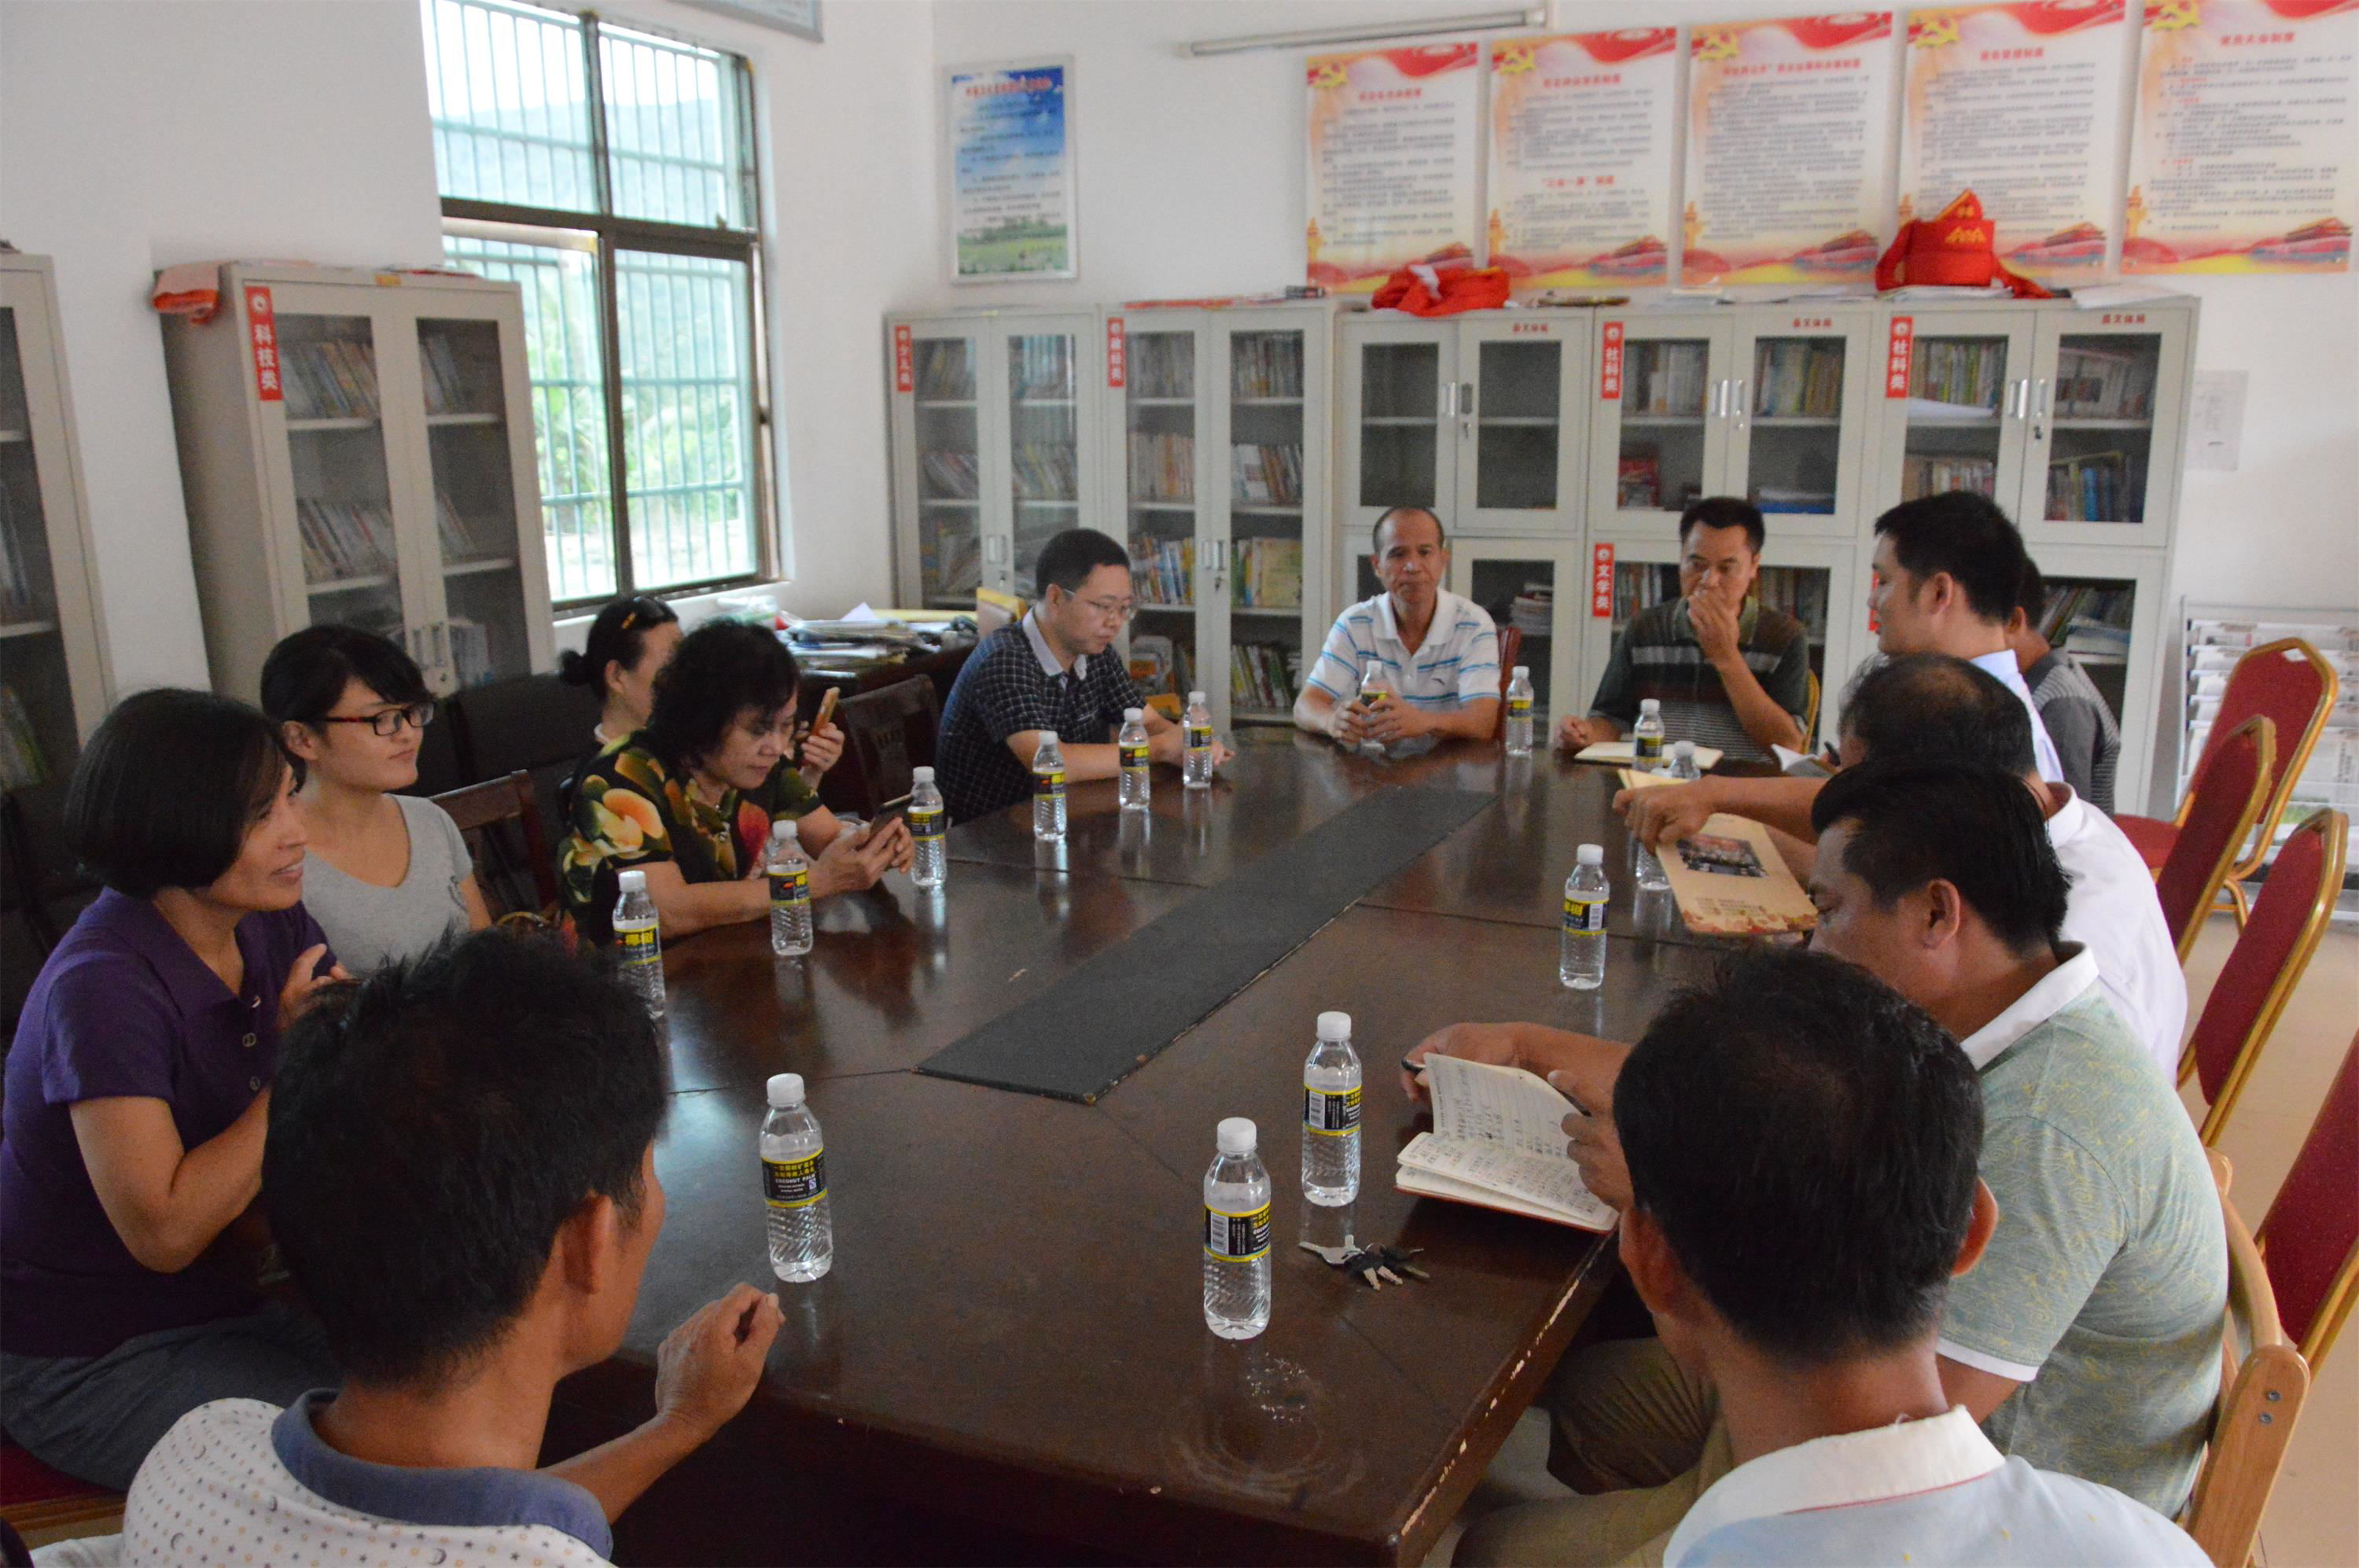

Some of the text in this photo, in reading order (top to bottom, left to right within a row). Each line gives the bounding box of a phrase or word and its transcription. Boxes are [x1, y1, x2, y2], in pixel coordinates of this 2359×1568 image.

[253, 323, 279, 391] 科技类
[1890, 339, 1908, 390] 社科类
[1595, 565, 1610, 609] 文学类
